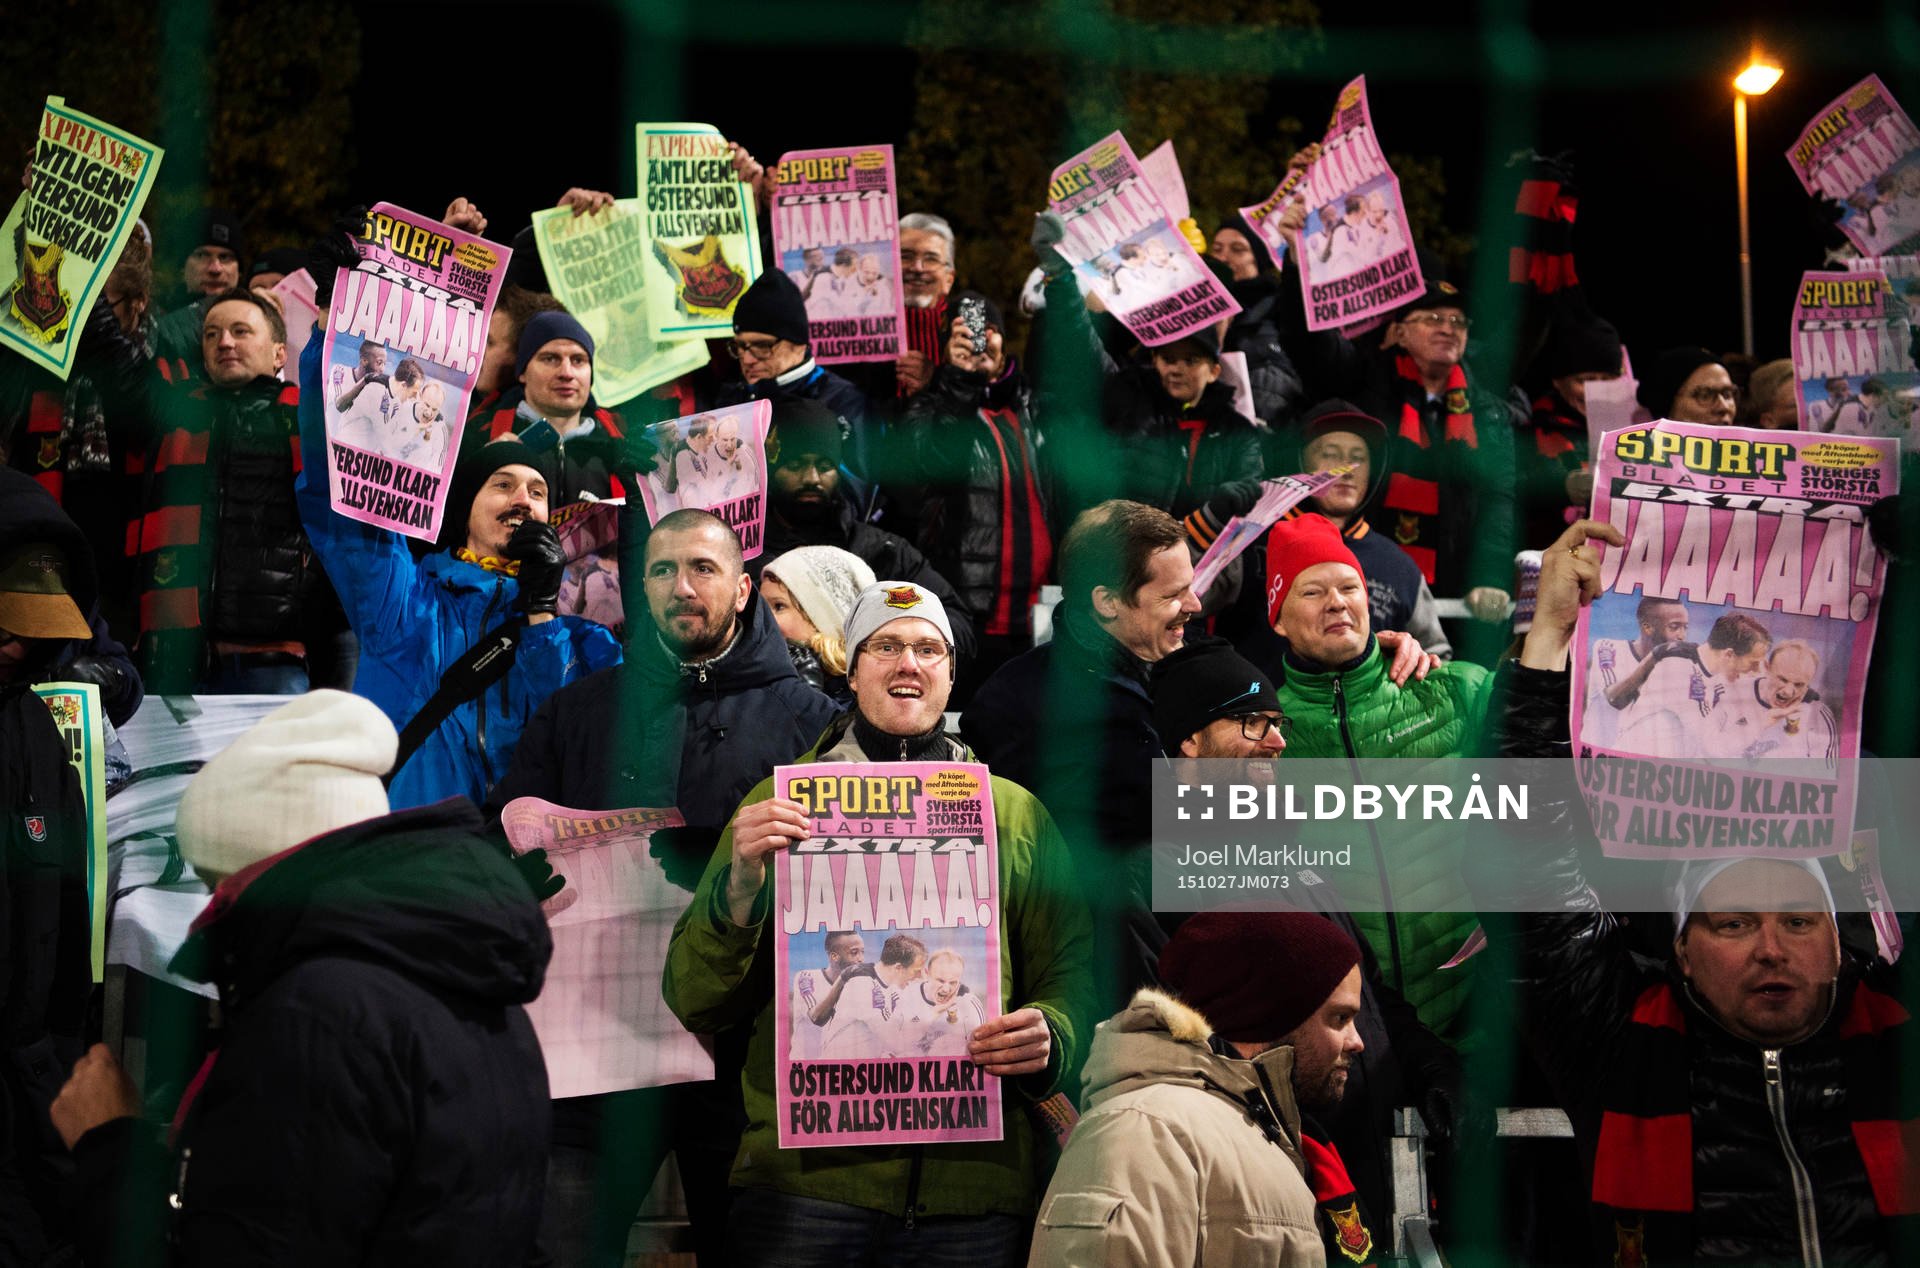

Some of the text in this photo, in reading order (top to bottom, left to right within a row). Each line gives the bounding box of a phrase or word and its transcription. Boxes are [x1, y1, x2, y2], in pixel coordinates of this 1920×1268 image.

[776, 156, 850, 185] SPORT
[32, 167, 118, 233] TERSUND
[647, 186, 737, 212] ÖSTERSUND
[657, 211, 743, 238] ALLSVENSKAN
[448, 272, 488, 295] STÖRSTA
[451, 262, 493, 284] SVERIGES
[1800, 280, 1877, 306] SPORT
[335, 269, 484, 376] JAAAAA!
[860, 316, 897, 337] KLART
[816, 336, 899, 357] ALLSVENSKAN
[1616, 429, 1796, 480] SPORT
[392, 464, 441, 503] KLART
[1622, 465, 1788, 494] BLADET
[1801, 465, 1881, 480] SVERIGES
[1801, 476, 1880, 494] STÖRSTA
[1621, 482, 1865, 524] EXTRA
[941, 780, 978, 788] Aftonbladet
[947, 773, 966, 781] köpet
[1580, 745, 1839, 815] ÖSTERSUND KLART
[789, 776, 921, 819] SPORT
[926, 800, 982, 812] SVERIGES
[958, 789, 971, 798] dag
[817, 821, 917, 834] LADET
[926, 812, 983, 826] STÖRSTA
[927, 825, 984, 837] sporttidning
[1624, 804, 1836, 848] ALLSVENSKAN
[796, 838, 977, 852] EXTRA
[783, 844, 992, 935] JAAAAA!
[789, 1059, 986, 1098] ÖSTERSUND KLART
[790, 1096, 988, 1135] FÖR ALLSVENSKAN
